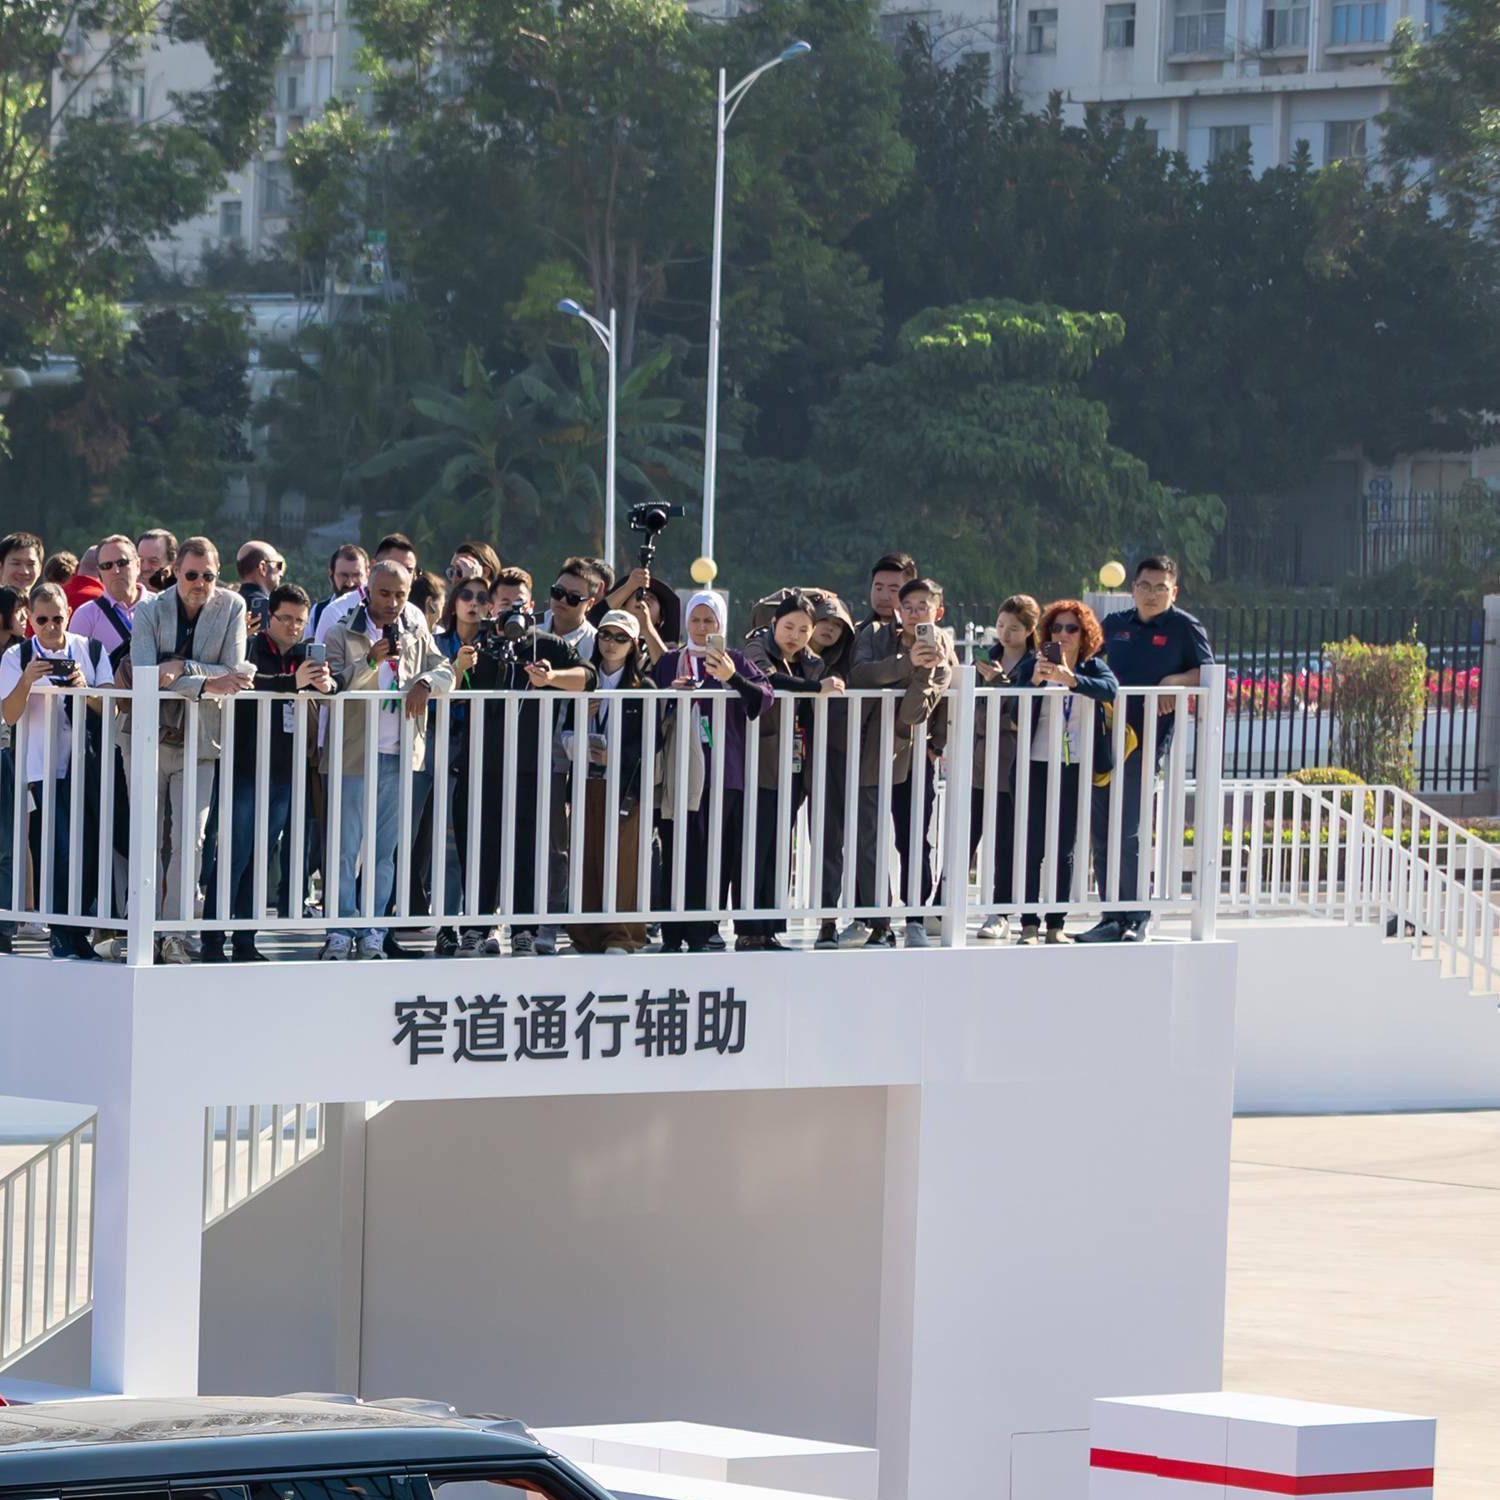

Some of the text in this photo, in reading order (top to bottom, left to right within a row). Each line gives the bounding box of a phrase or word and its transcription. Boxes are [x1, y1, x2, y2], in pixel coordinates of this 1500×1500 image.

[392, 986, 747, 1066] 窄道通行辅助
